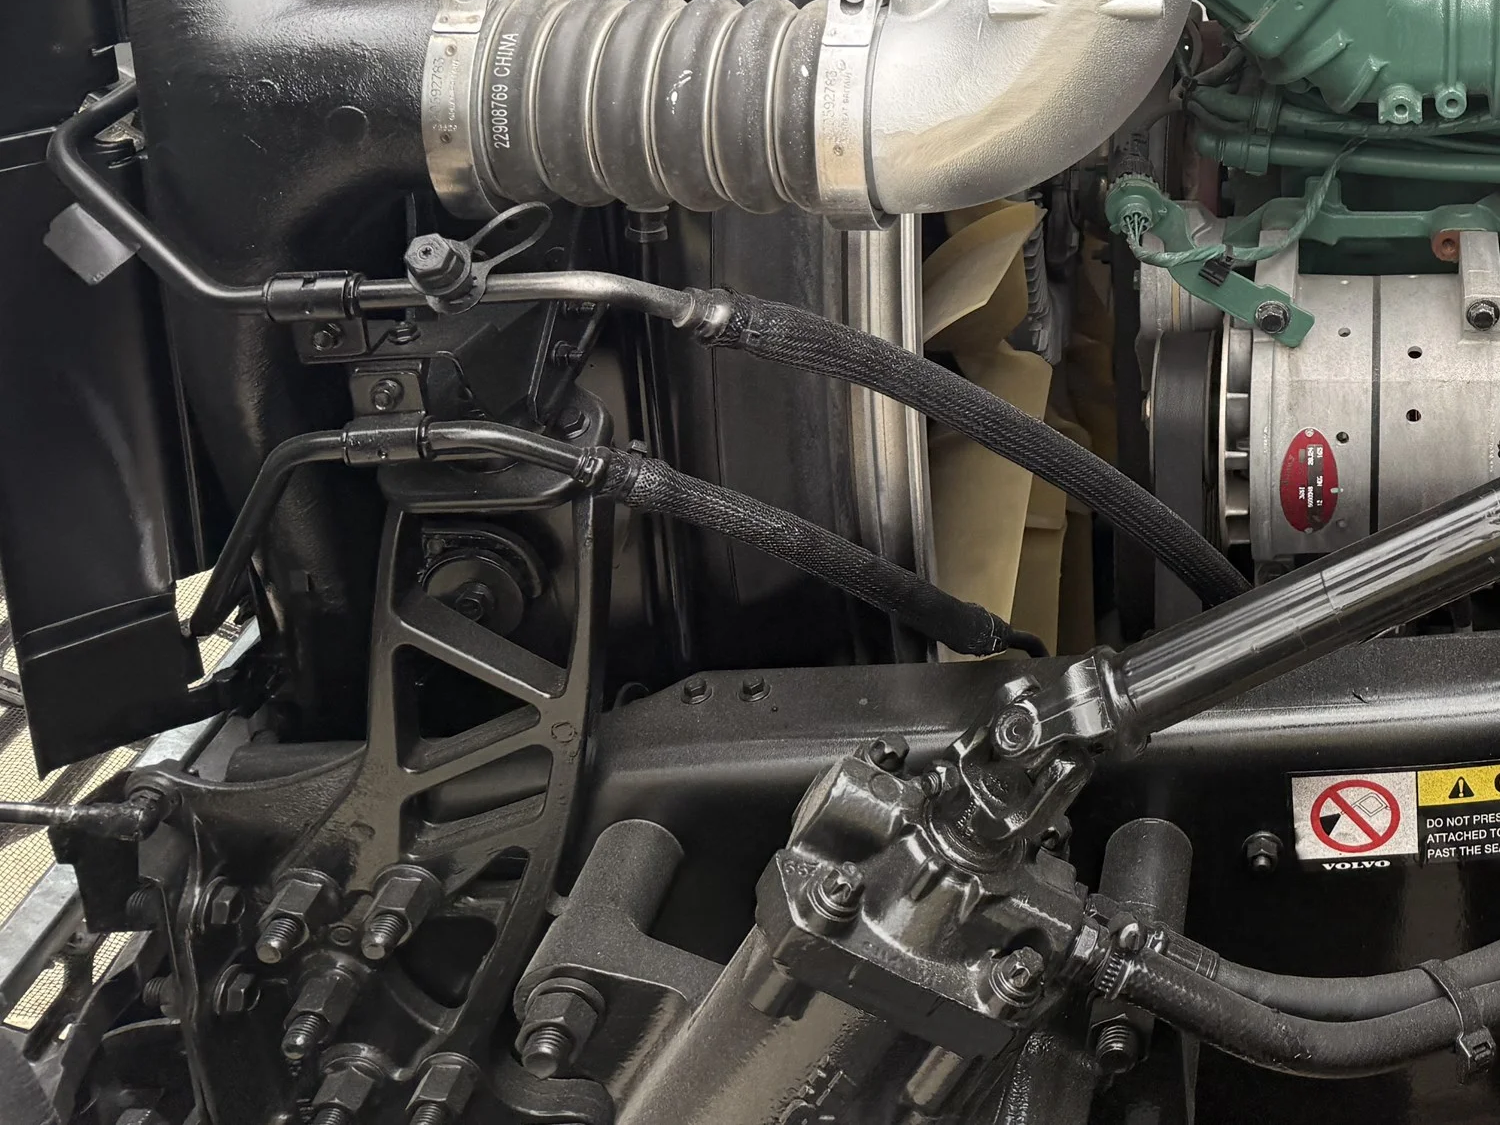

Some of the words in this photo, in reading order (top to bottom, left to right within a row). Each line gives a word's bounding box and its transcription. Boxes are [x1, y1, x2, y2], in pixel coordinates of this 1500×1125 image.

[494, 32, 520, 78] CHINA
[490, 83, 511, 149] 22908769
[1426, 817, 1444, 829] DO
[1446, 815, 1470, 827] NOT
[1427, 829, 1487, 844] ATTACHED
[1427, 847, 1456, 859] PAST
[1459, 845, 1482, 856] THE
[1322, 859, 1391, 871] VOLVO
